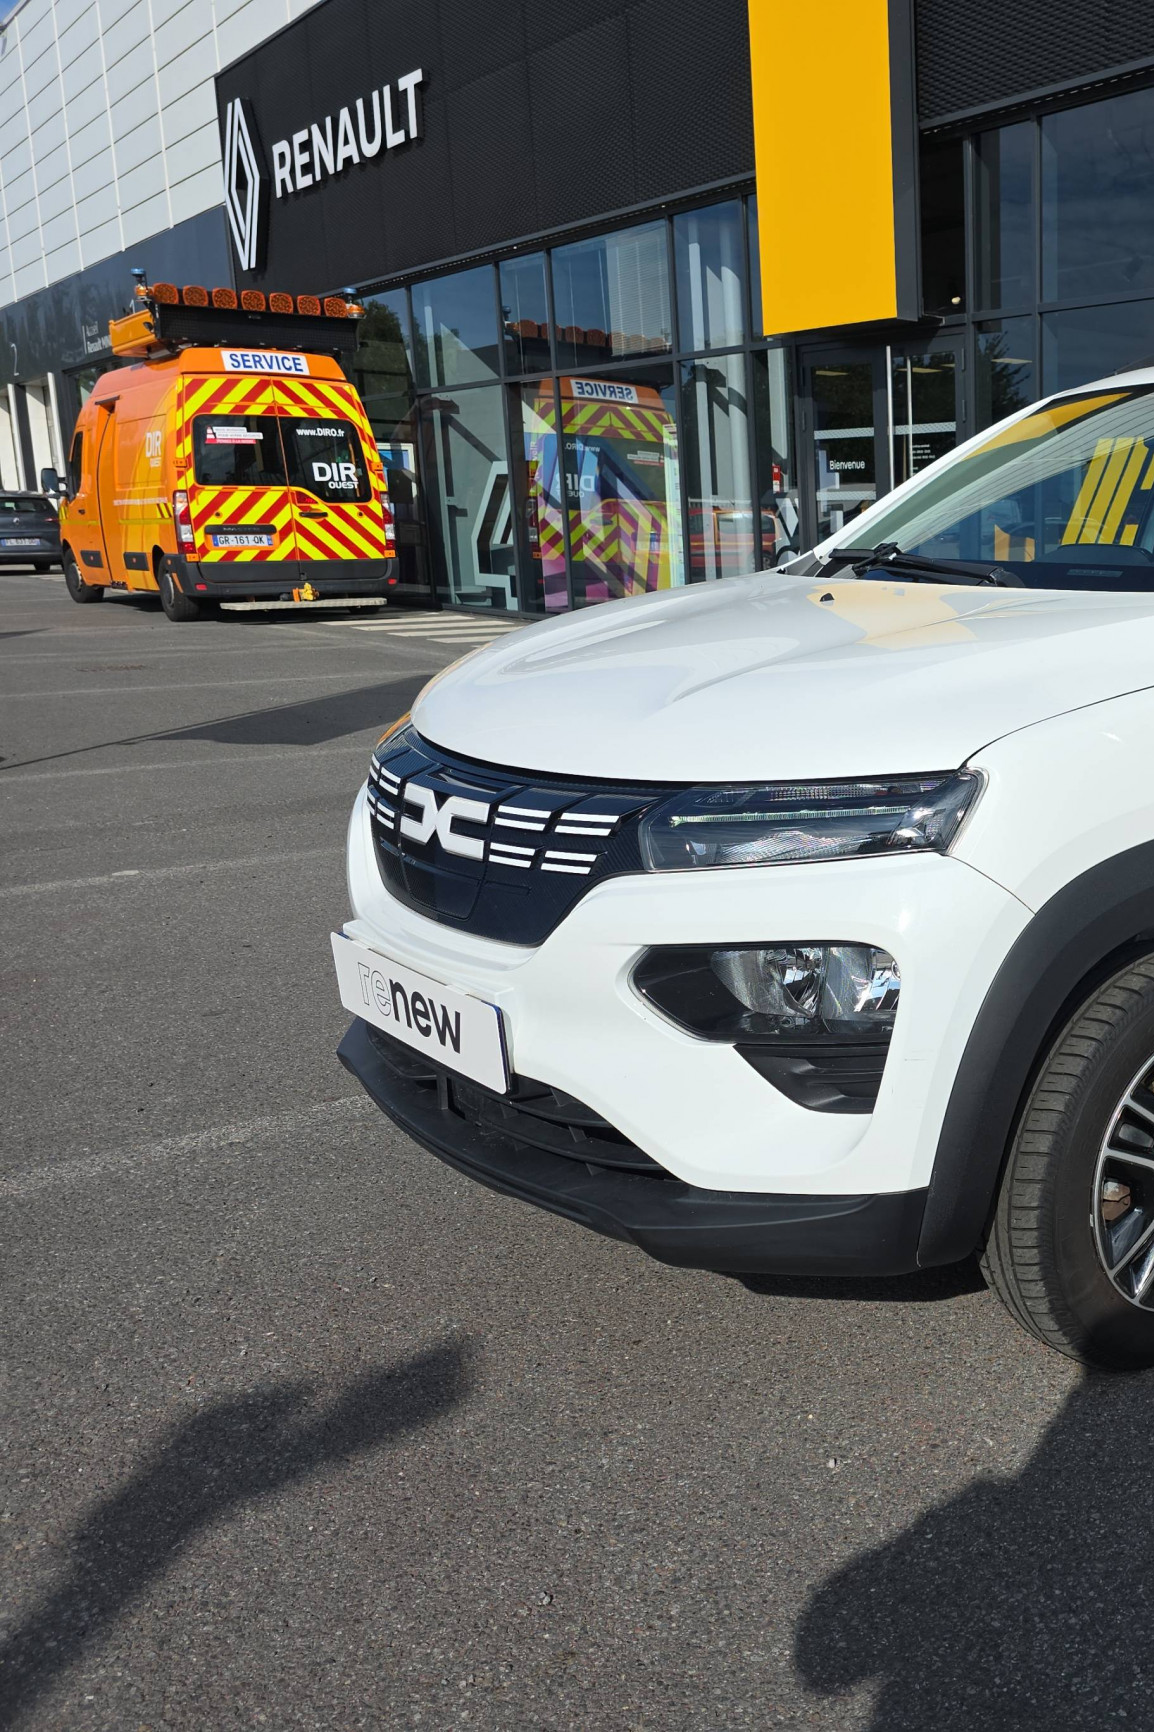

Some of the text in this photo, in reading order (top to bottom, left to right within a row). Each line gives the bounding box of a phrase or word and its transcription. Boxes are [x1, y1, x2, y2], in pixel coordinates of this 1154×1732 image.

[272, 68, 423, 199] RENAULT
[229, 353, 304, 373] SERVICE
[296, 427, 345, 437] www.DIRO.fr
[145, 430, 162, 457] DIR
[312, 462, 358, 482] DIR
[829, 460, 866, 470] Bienvenue
[328, 481, 359, 489] OUEST
[357, 961, 461, 1055] renew
